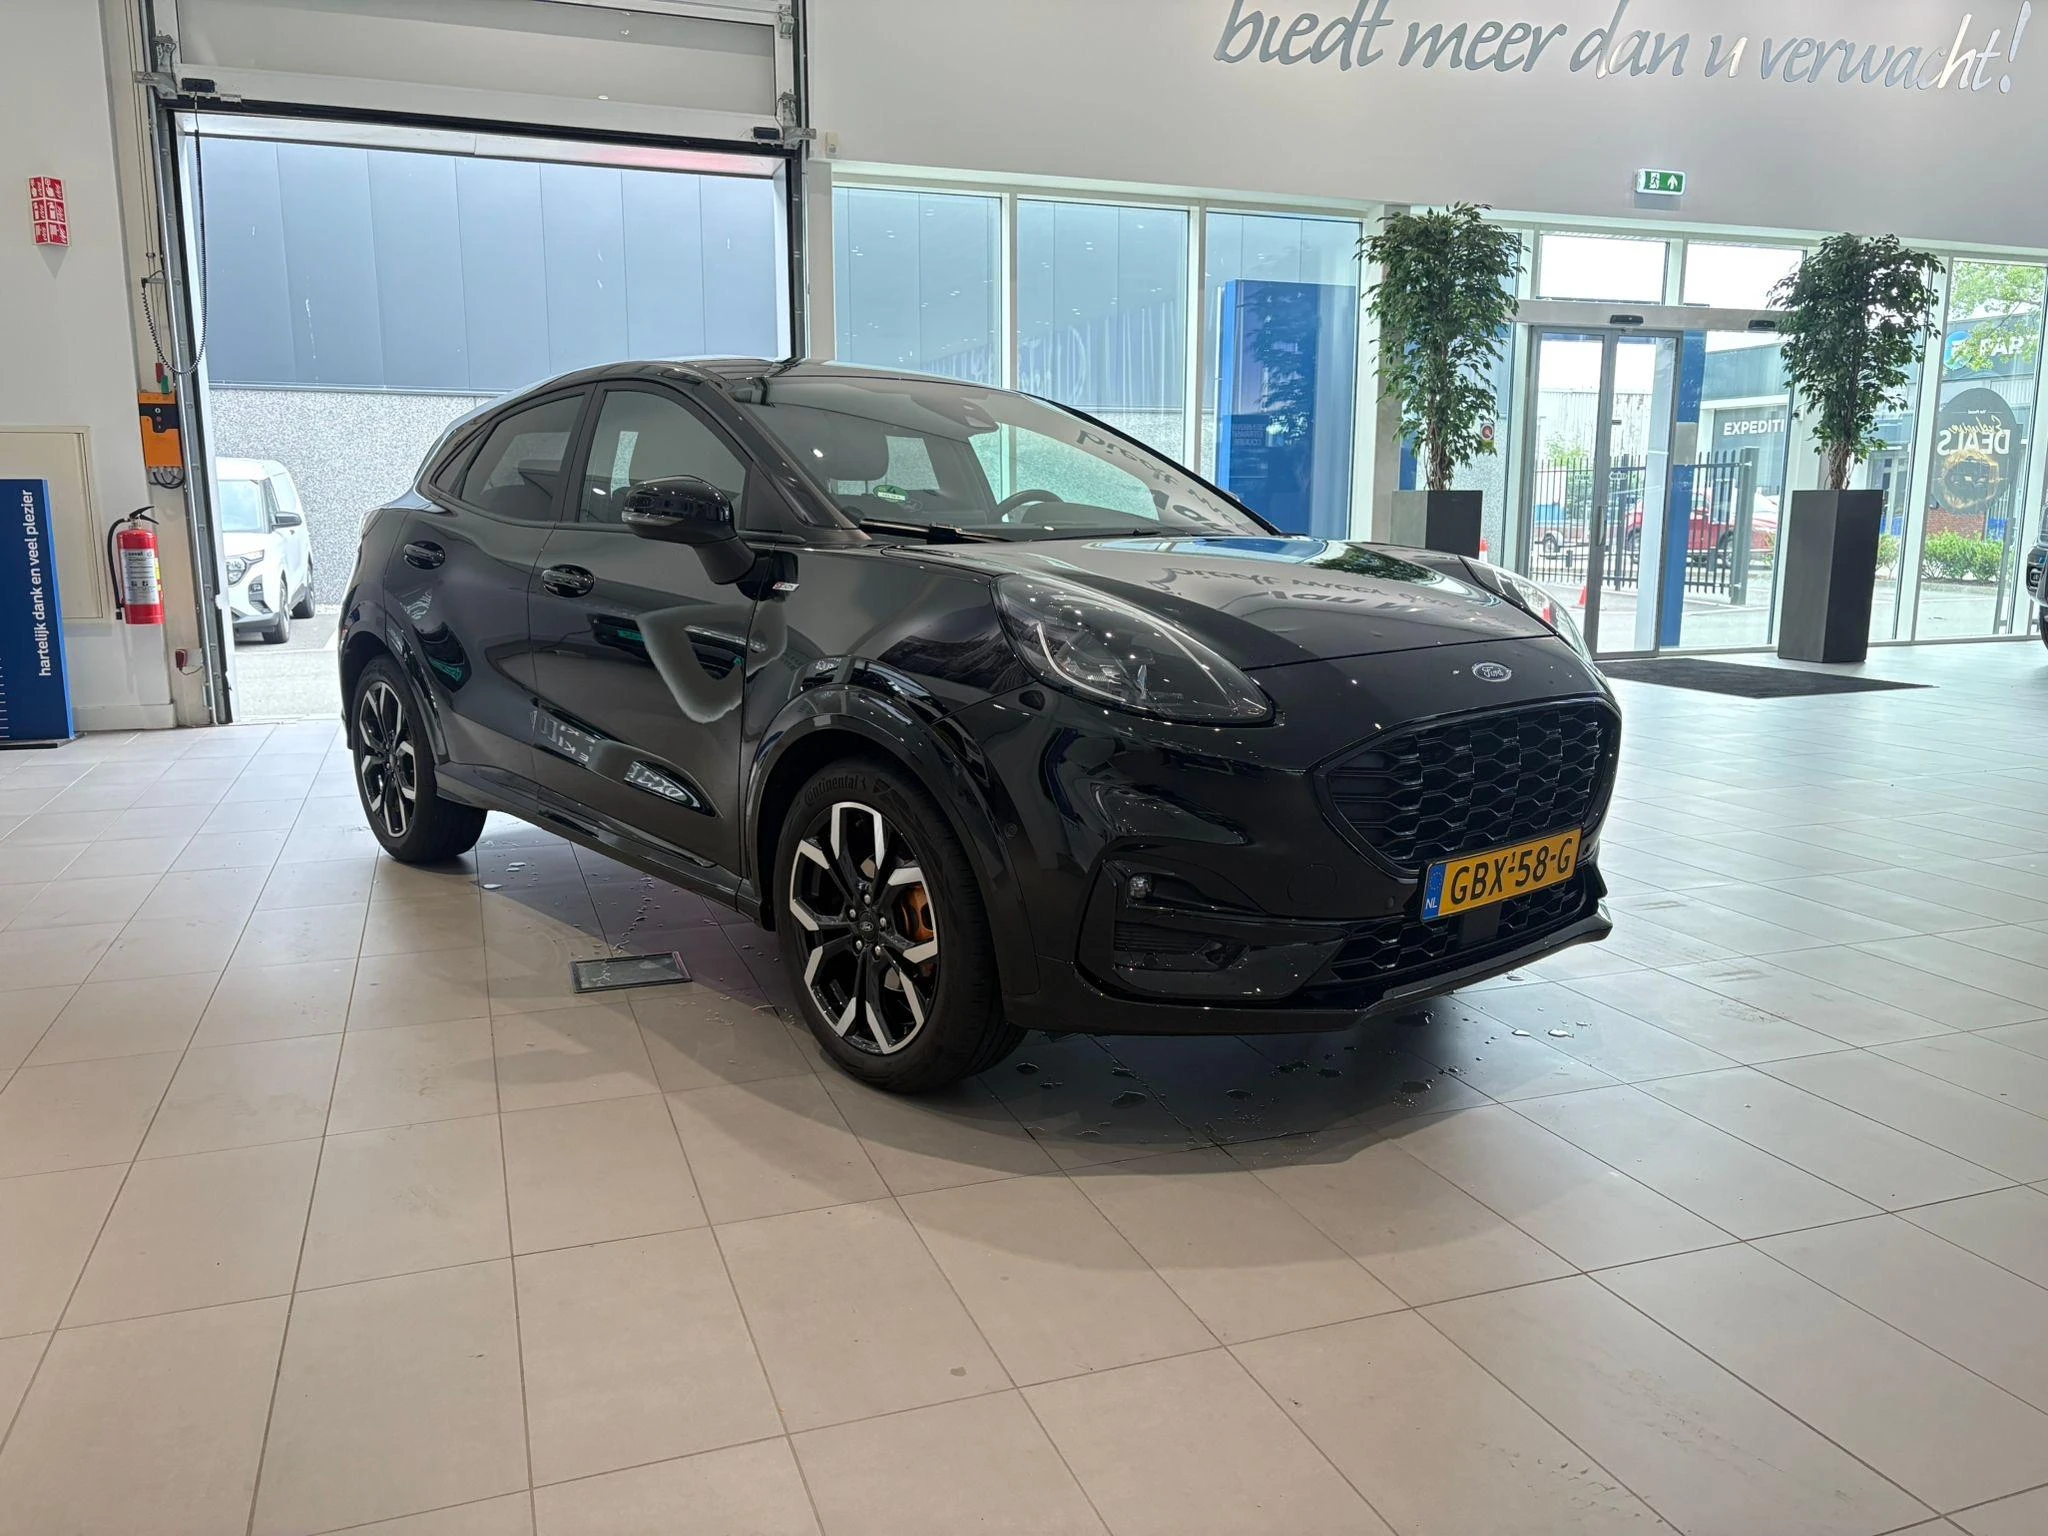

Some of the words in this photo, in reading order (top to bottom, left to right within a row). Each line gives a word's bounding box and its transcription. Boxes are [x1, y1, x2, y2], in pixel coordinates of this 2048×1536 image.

[1213, 0, 1394, 71] biedt
[1398, 21, 1568, 72] meer
[1569, 0, 1690, 79] dan
[1704, 34, 1748, 78] u
[1760, 0, 2032, 94] verwacht!
[20, 489, 39, 536] plezier
[24, 537, 40, 567] veel
[29, 567, 42, 585] en
[30, 586, 46, 620] dank
[33, 622, 52, 677] hartelijk
[1450, 837, 1573, 905] GBX-58-G
[1425, 897, 1438, 910] NL
